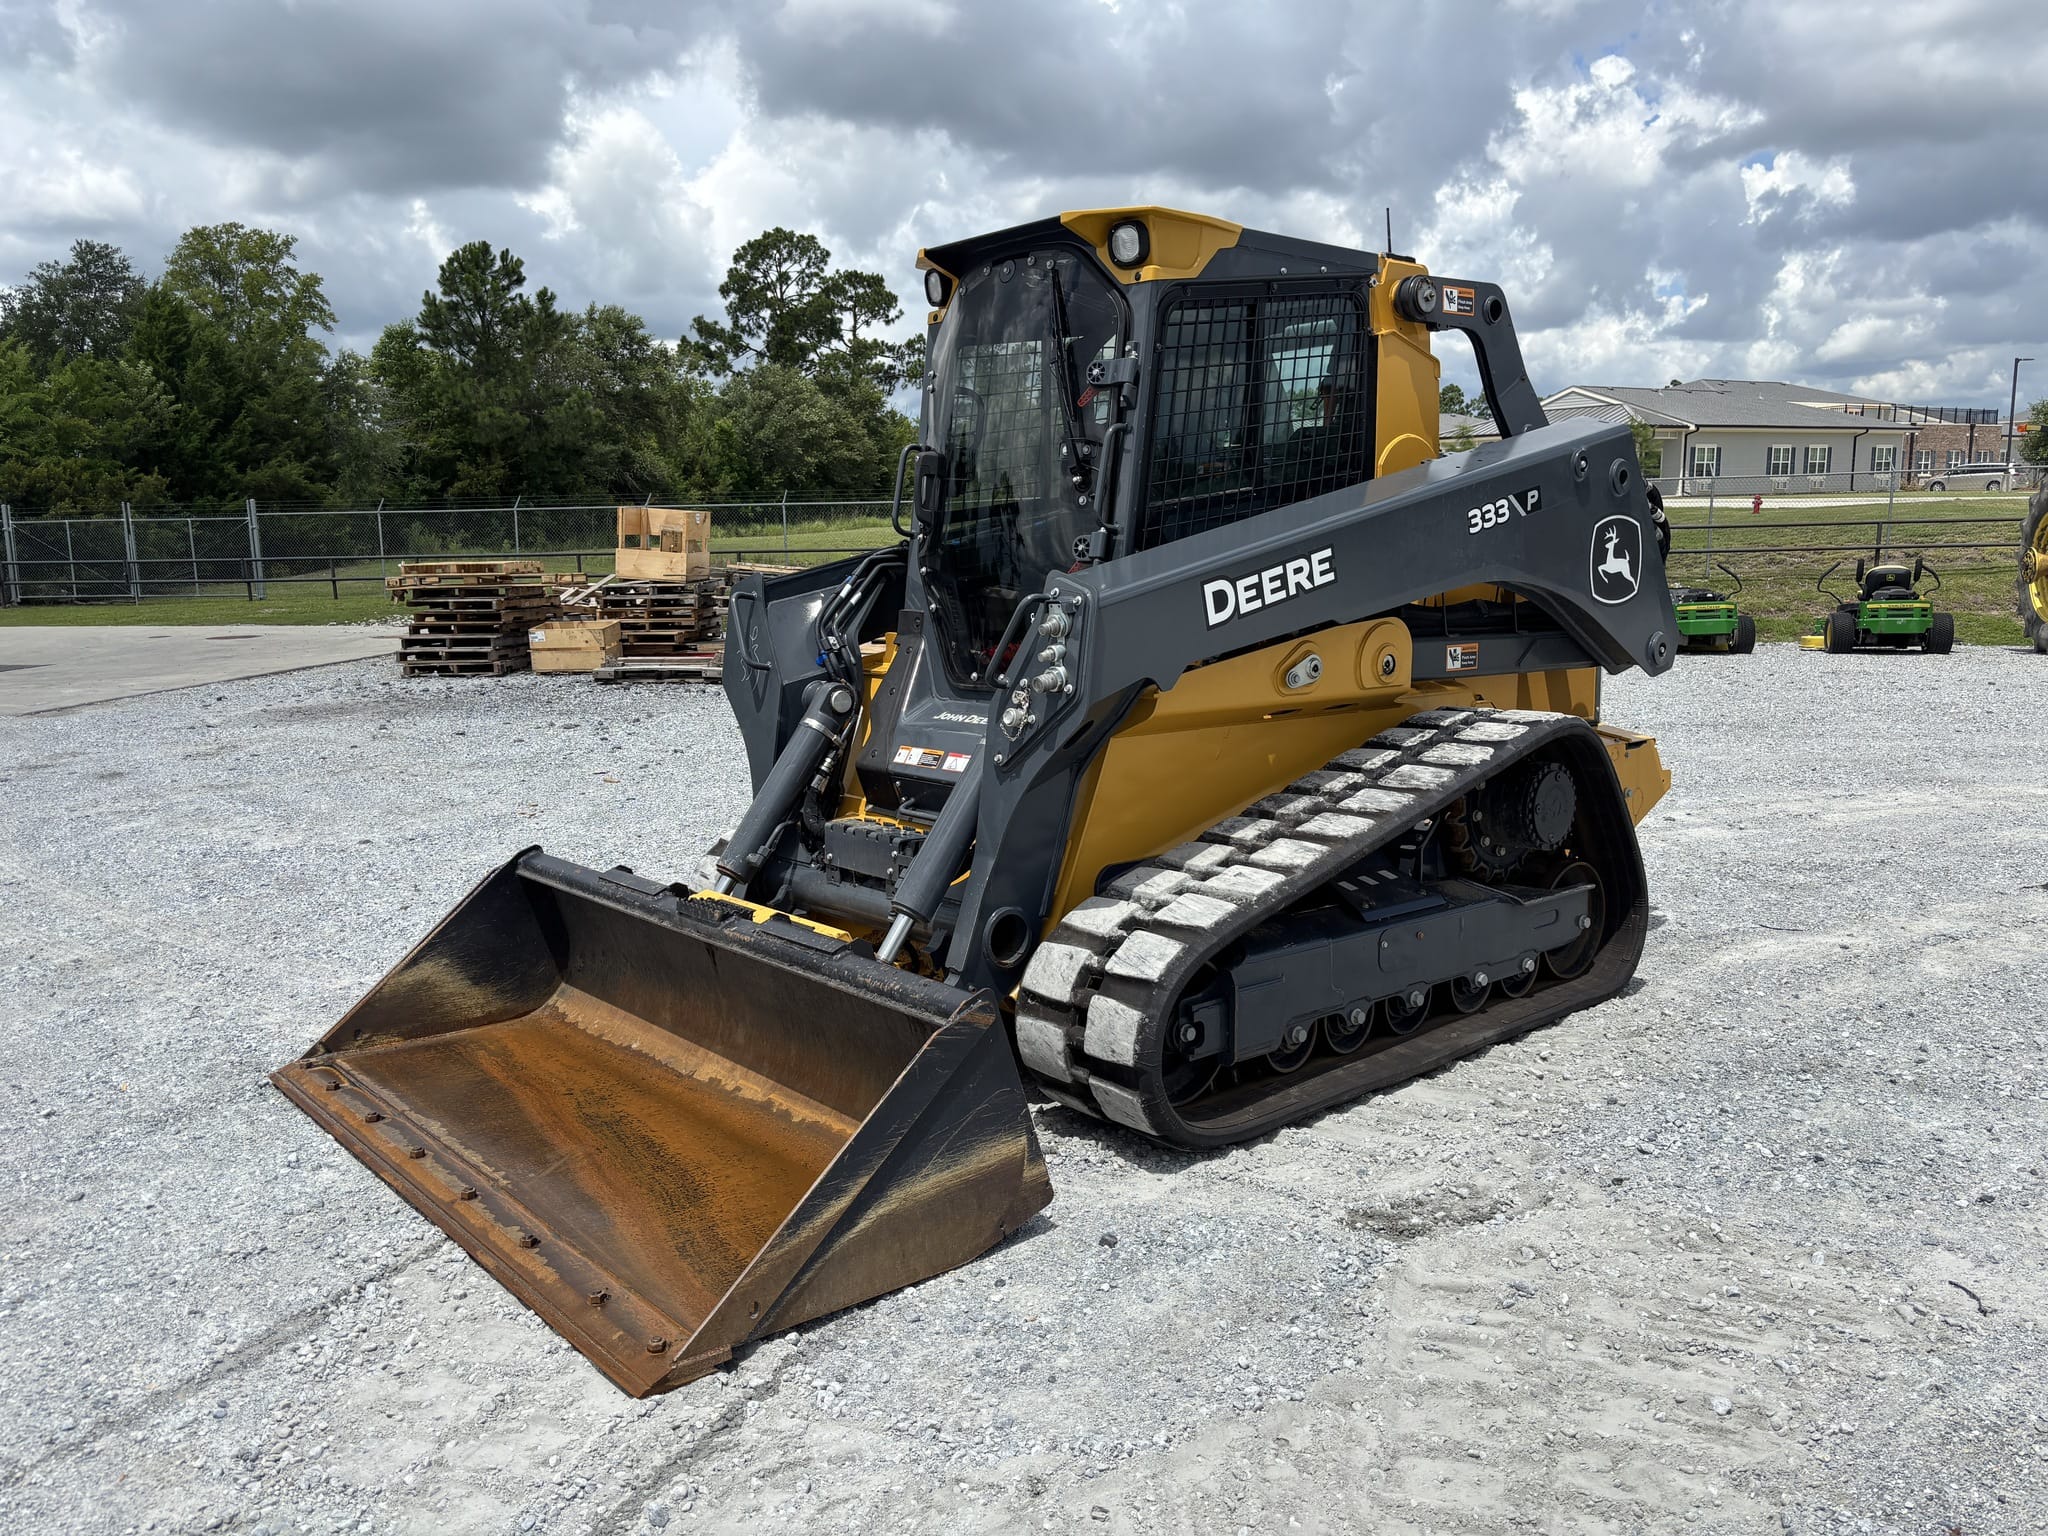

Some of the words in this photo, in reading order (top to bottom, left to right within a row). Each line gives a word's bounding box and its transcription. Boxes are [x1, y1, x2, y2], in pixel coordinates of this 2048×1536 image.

[1203, 547, 1336, 626] DEERE
[933, 711, 967, 722] JOHN
[964, 715, 988, 724] DEE
